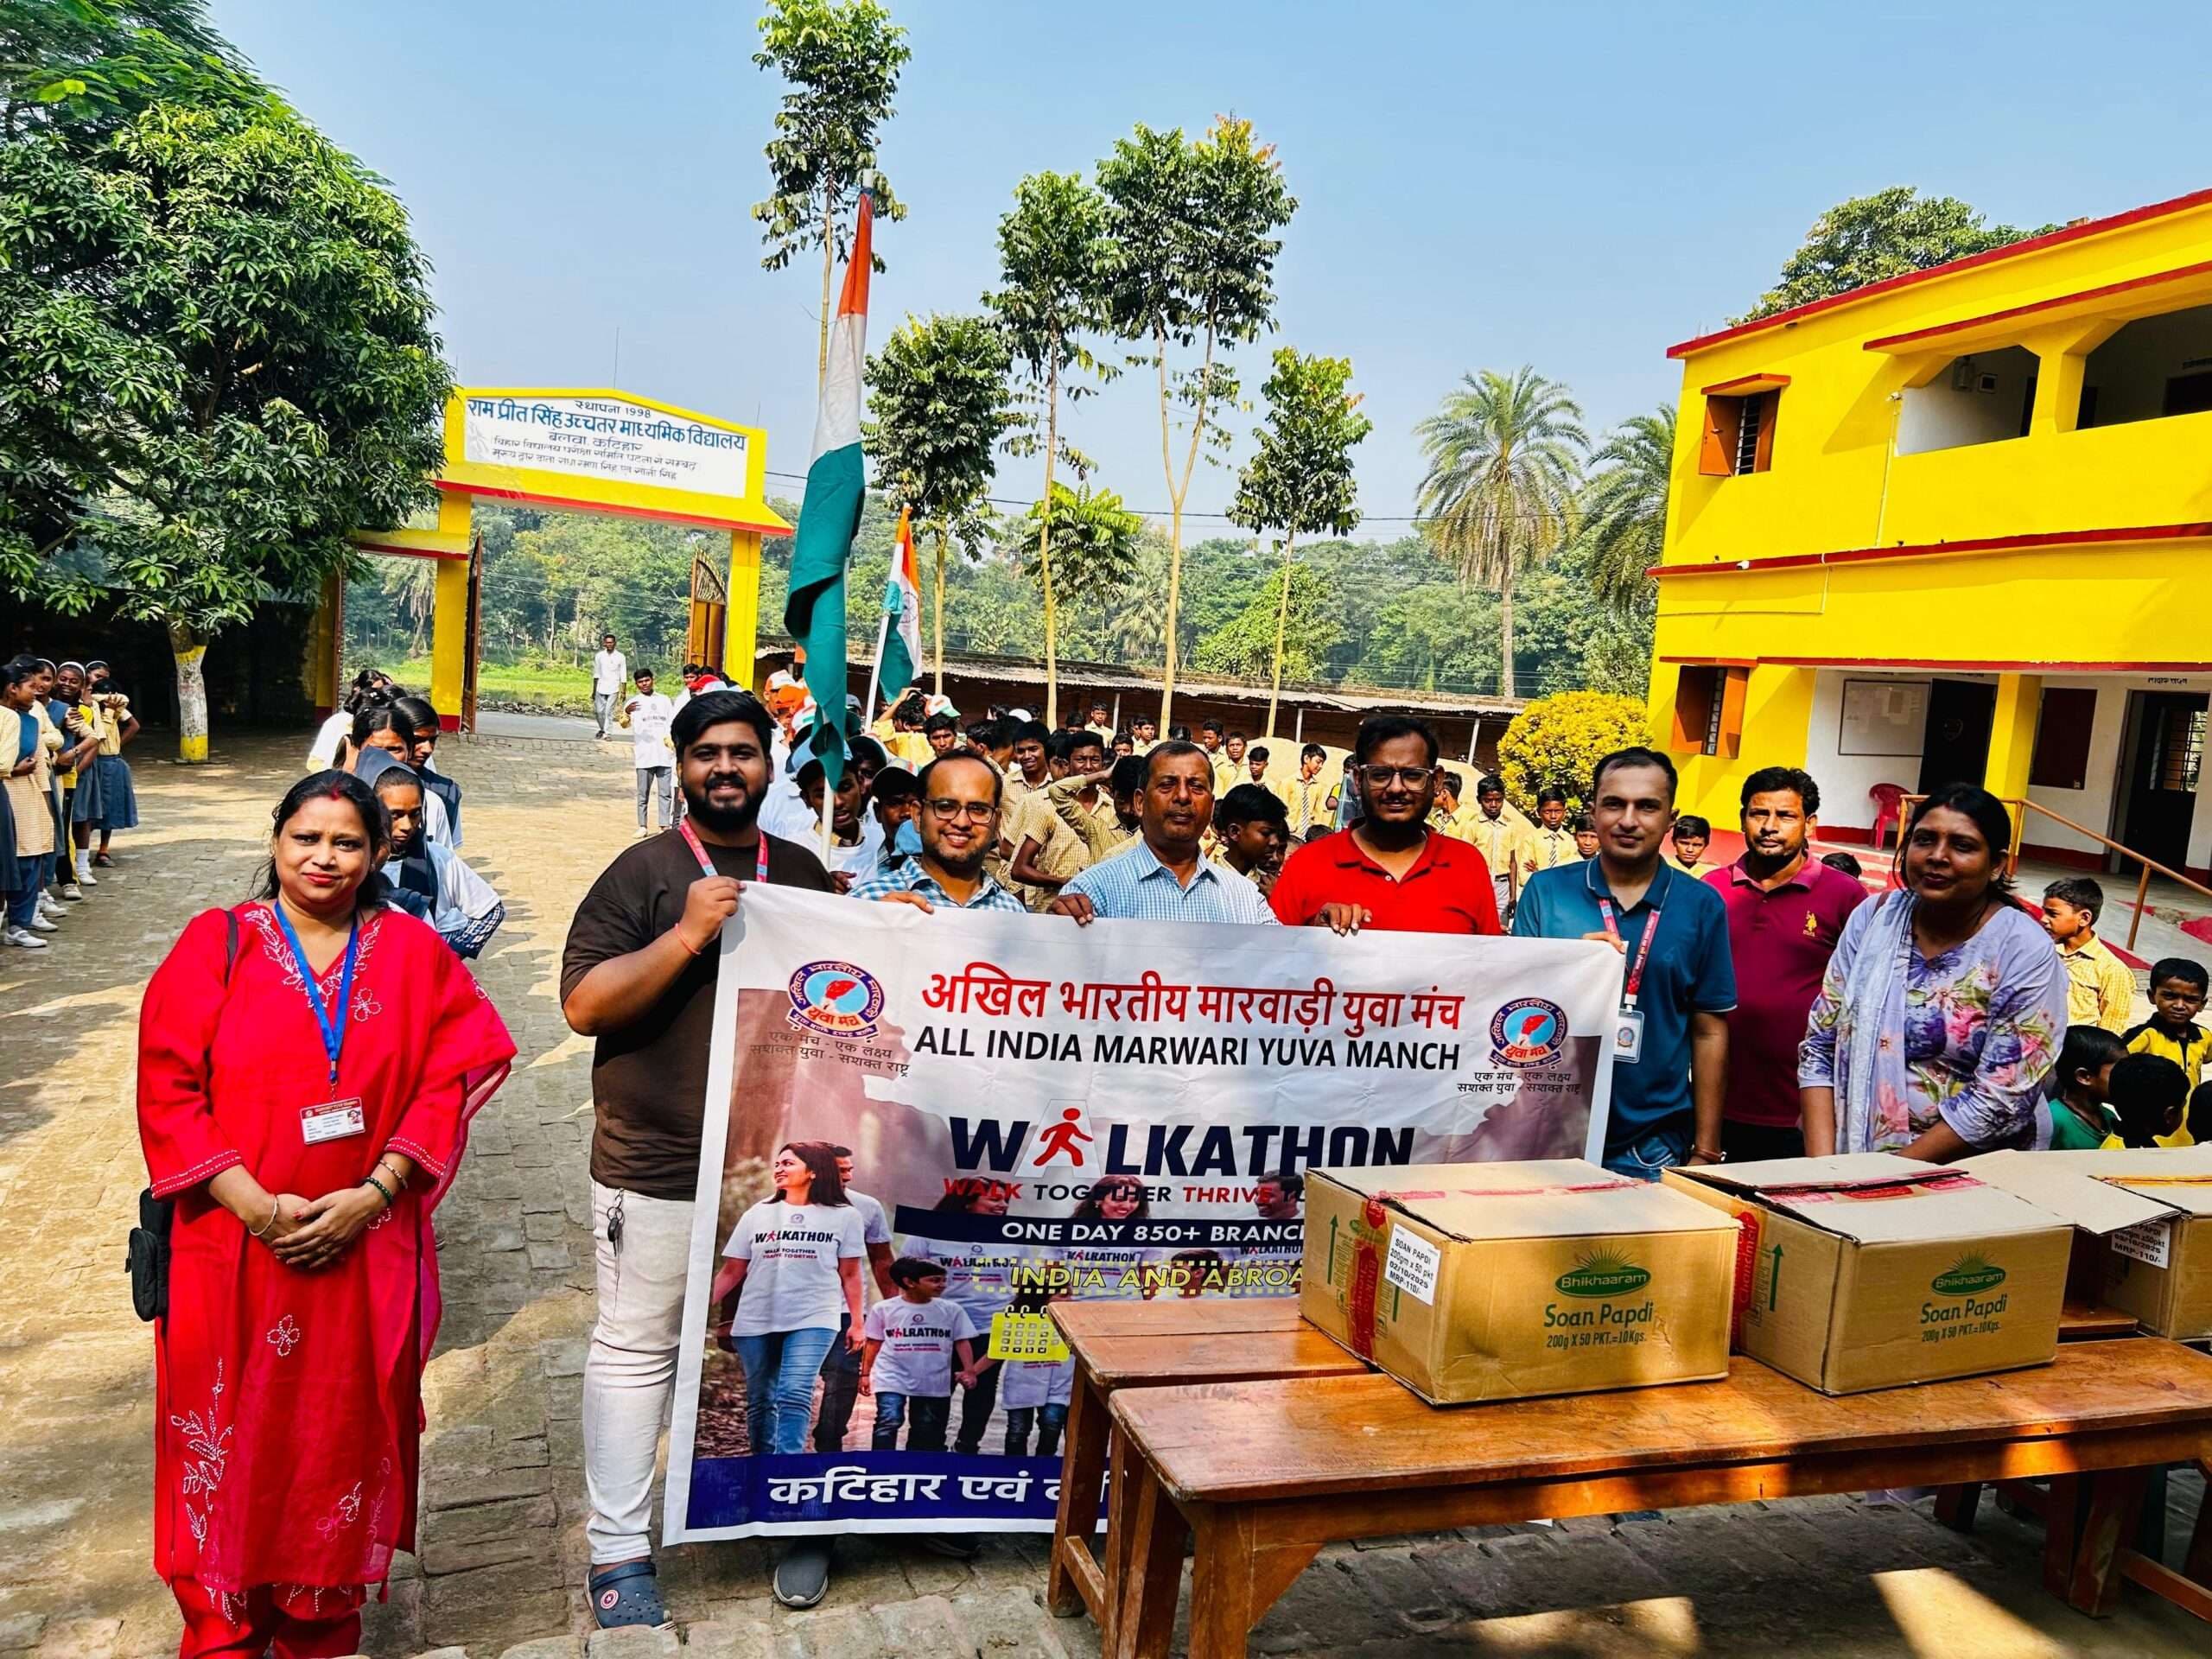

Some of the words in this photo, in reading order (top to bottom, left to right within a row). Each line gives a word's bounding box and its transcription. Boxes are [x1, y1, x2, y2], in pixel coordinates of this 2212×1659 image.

[574, 400, 621, 415] स्थापना
[626, 407, 652, 418] 1998
[467, 398, 496, 418] राम
[498, 398, 528, 422] प्रीत
[531, 404, 564, 429] सिंह
[564, 412, 617, 434] उच्चतर
[620, 420, 685, 442] माध्यमिक
[687, 424, 747, 451] विद्यालय
[593, 436, 643, 451] कटिहार
[921, 961, 1052, 1018] अखिल
[1059, 970, 1191, 1023] भारतीय
[1198, 976, 1337, 1035] मारवाड़ी
[1343, 990, 1406, 1039] युवा
[1410, 985, 1466, 1030] मंच
[807, 1007, 835, 1026] युवा
[769, 1031, 793, 1042] एक
[836, 1041, 857, 1053] एक
[861, 1046, 893, 1058] लक्ष्य
[913, 1025, 981, 1058] ALL
[986, 1030, 1083, 1063] INDIA
[1093, 1035, 1248, 1066] MARWARI
[1258, 1038, 1337, 1068] YUVA
[1345, 1040, 1460, 1071] MANCH
[799, 1047, 825, 1059] युवा
[838, 1053, 882, 1071] सशक्त
[1457, 1083, 1494, 1093] सशक्त
[1497, 1083, 1516, 1095] युवा
[1474, 1072, 1494, 1083] एक
[1523, 1072, 1542, 1083] एक
[949, 1098, 1416, 1179] WALKATHON
[943, 1178, 1023, 1199] WALK
[1033, 1184, 1172, 1203] TOGTHER
[1183, 1186, 1274, 1203] THRIVE
[1001, 1222, 1062, 1241] ONE
[1071, 1224, 1127, 1242] DAY
[1133, 1225, 1201, 1243] 850+
[1395, 1238, 1411, 1253] SOAN
[1412, 1249, 1431, 1264] PAPDI
[1010, 1266, 1108, 1288] INDIA
[1117, 1268, 1191, 1288] AND
[1414, 1262, 1422, 1274] 50
[1561, 1274, 1647, 1287] Bhikhaaram
[1936, 1273, 2004, 1288] Bhikhaaram
[1544, 1303, 1594, 1327] Soan
[1599, 1300, 1654, 1328] Papdi
[1921, 1302, 1961, 1324] Soan
[1964, 1293, 2008, 1319] Papdi
[1547, 1334, 1569, 1350] 200g
[1580, 1332, 1591, 1346] 50
[767, 1465, 948, 1504] कटिहार
[957, 1470, 1034, 1503] एवं
